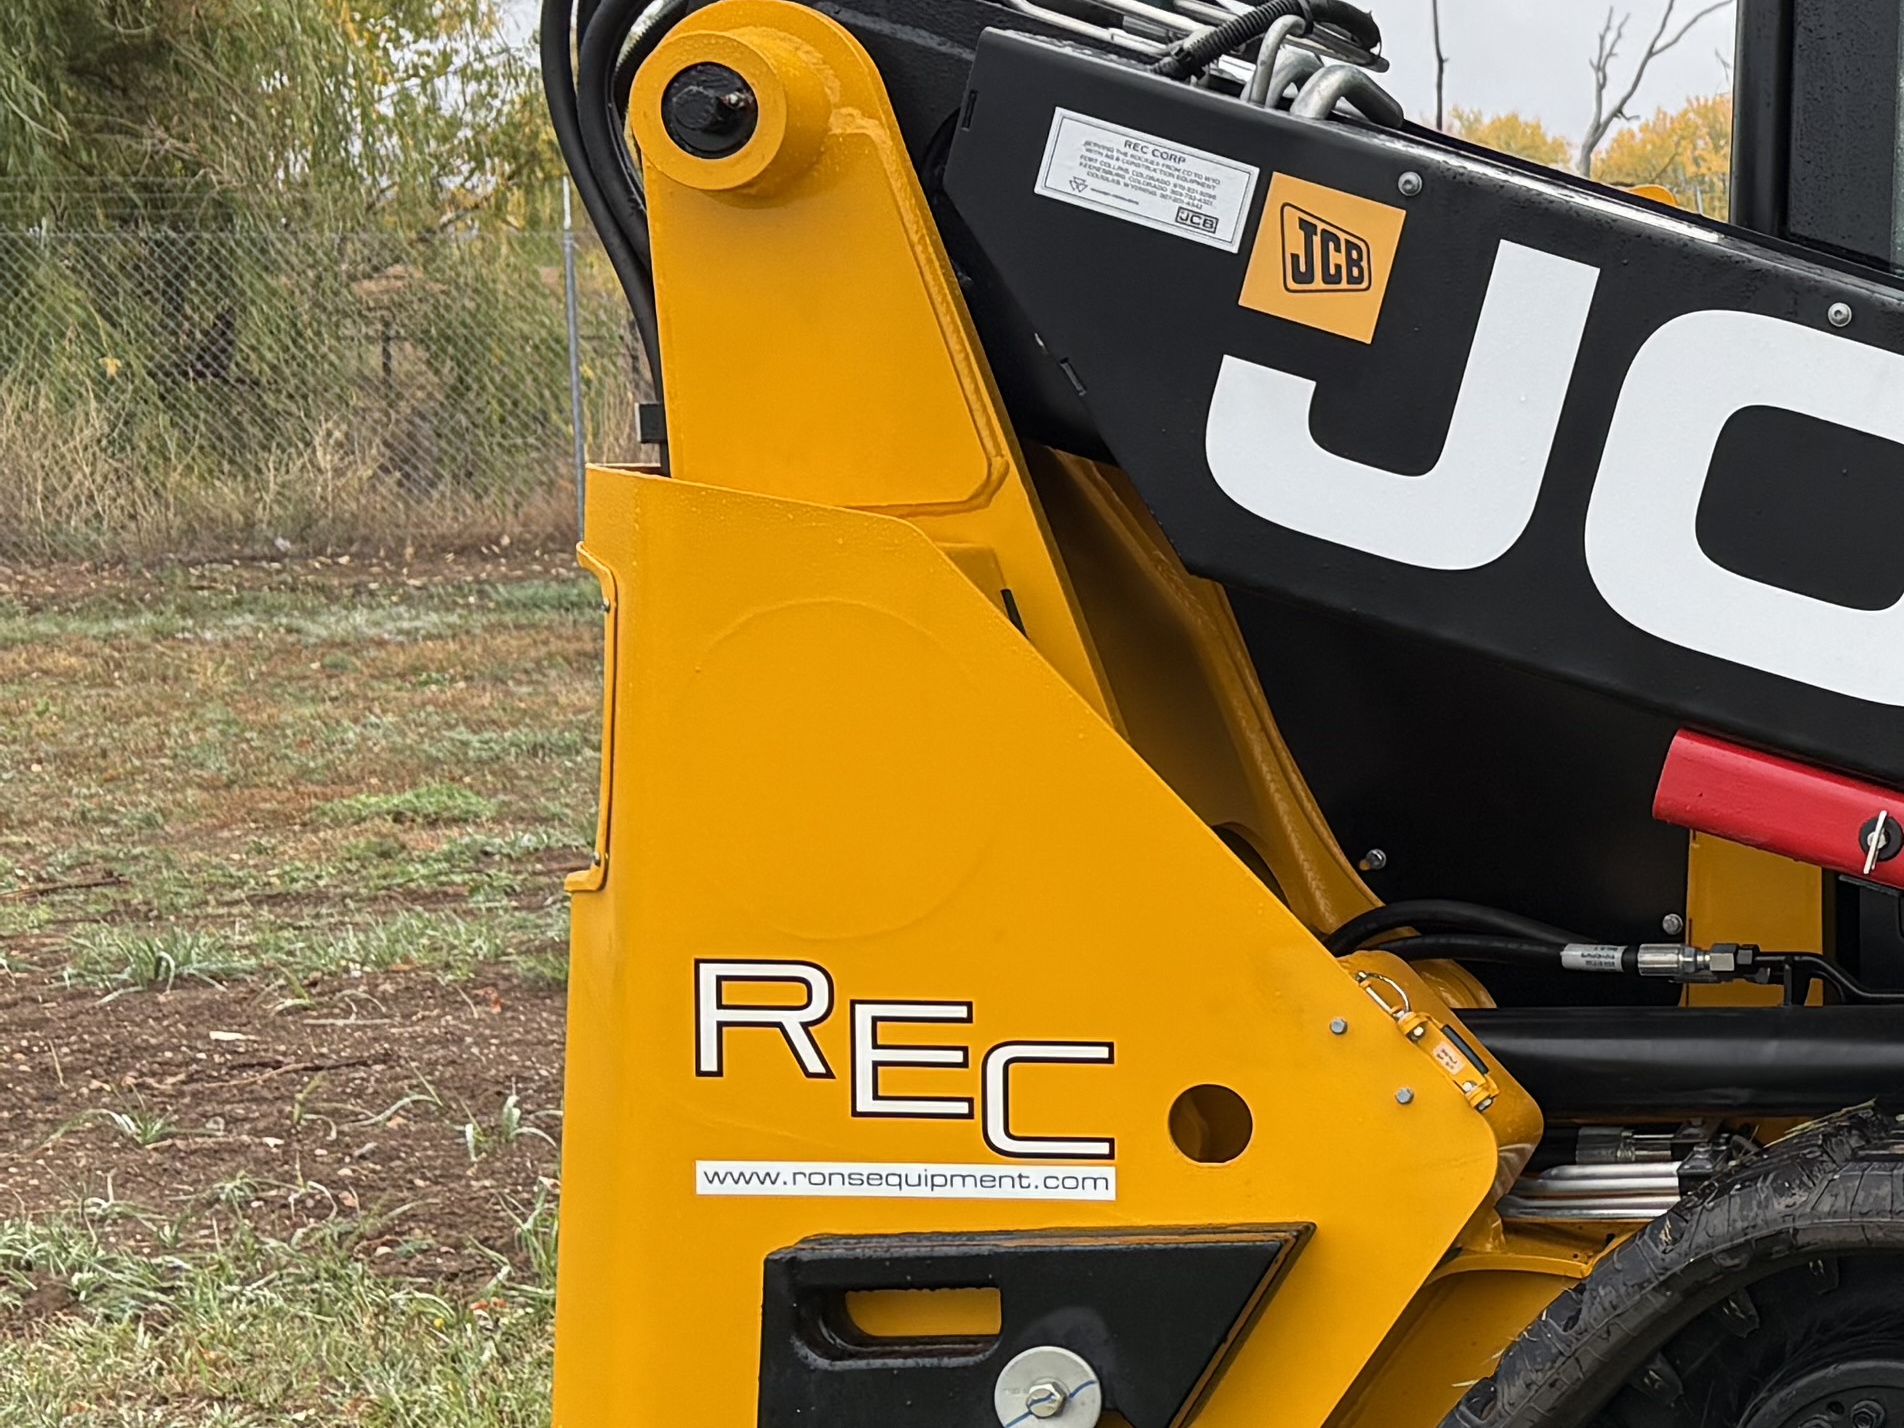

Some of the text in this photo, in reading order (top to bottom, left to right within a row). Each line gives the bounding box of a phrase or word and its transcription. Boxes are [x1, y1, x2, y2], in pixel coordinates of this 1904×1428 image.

[1123, 140, 1186, 165] REC CORP
[1179, 210, 1216, 230] JCB
[1290, 216, 1364, 285] JCB
[694, 958, 1115, 1160] REC
[703, 1168, 1110, 1192] www.ronsequipment.com
